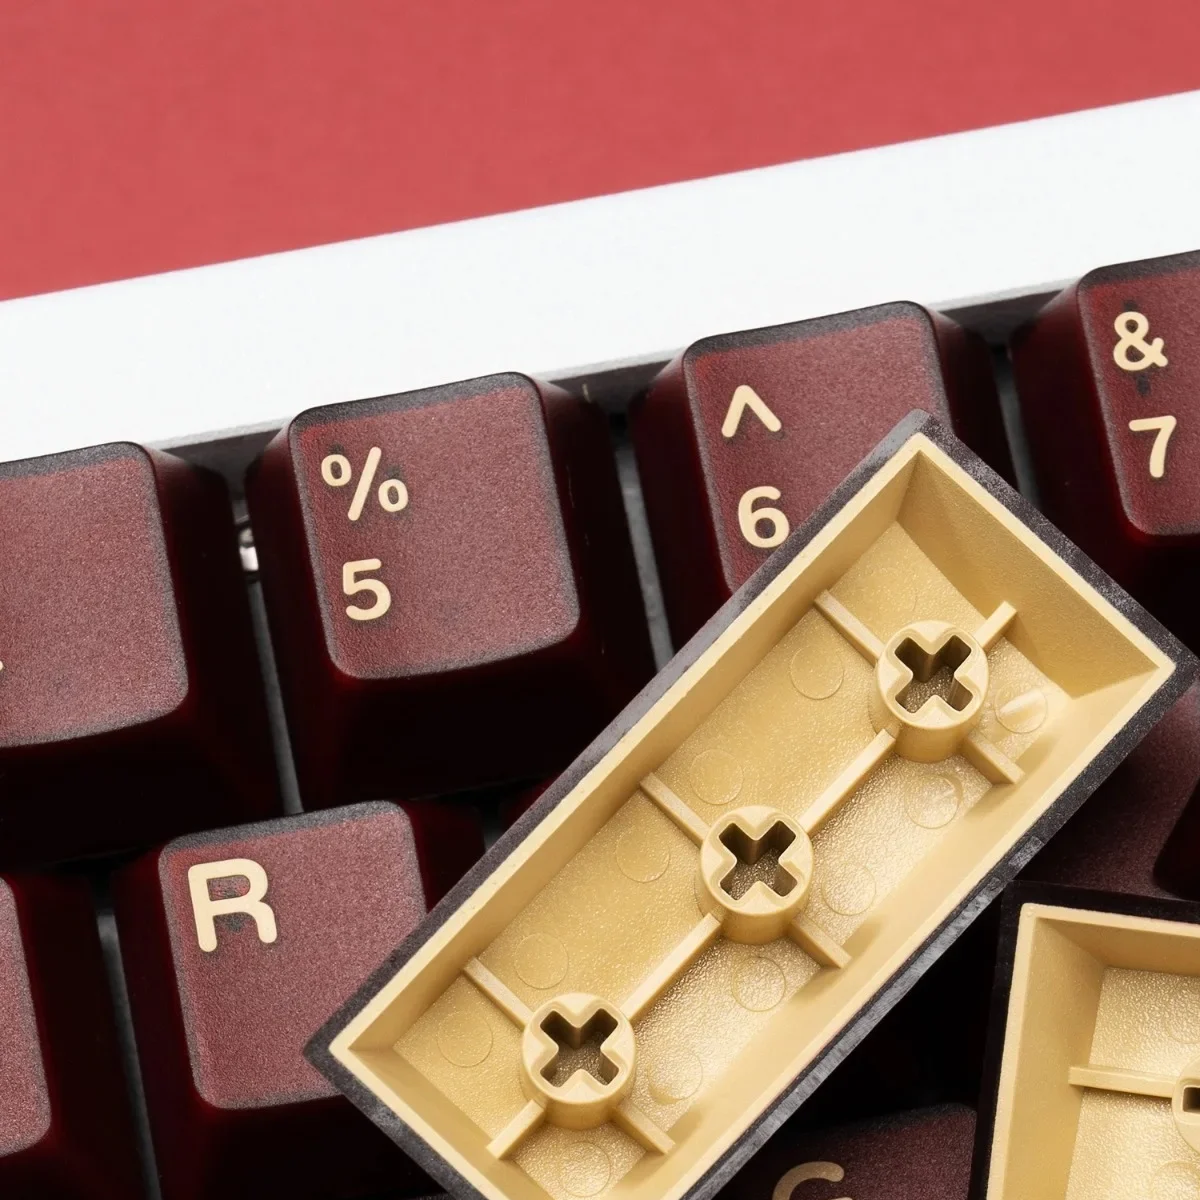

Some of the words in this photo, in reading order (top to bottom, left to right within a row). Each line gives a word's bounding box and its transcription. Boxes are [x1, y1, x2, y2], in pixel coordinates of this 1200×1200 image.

[1112, 311, 1169, 371] &
[720, 384, 783, 438] ^
[1128, 415, 1178, 479] 7
[320, 446, 410, 522] %
[737, 485, 791, 549] 6
[342, 558, 392, 622] 5
[187, 857, 279, 953] R
